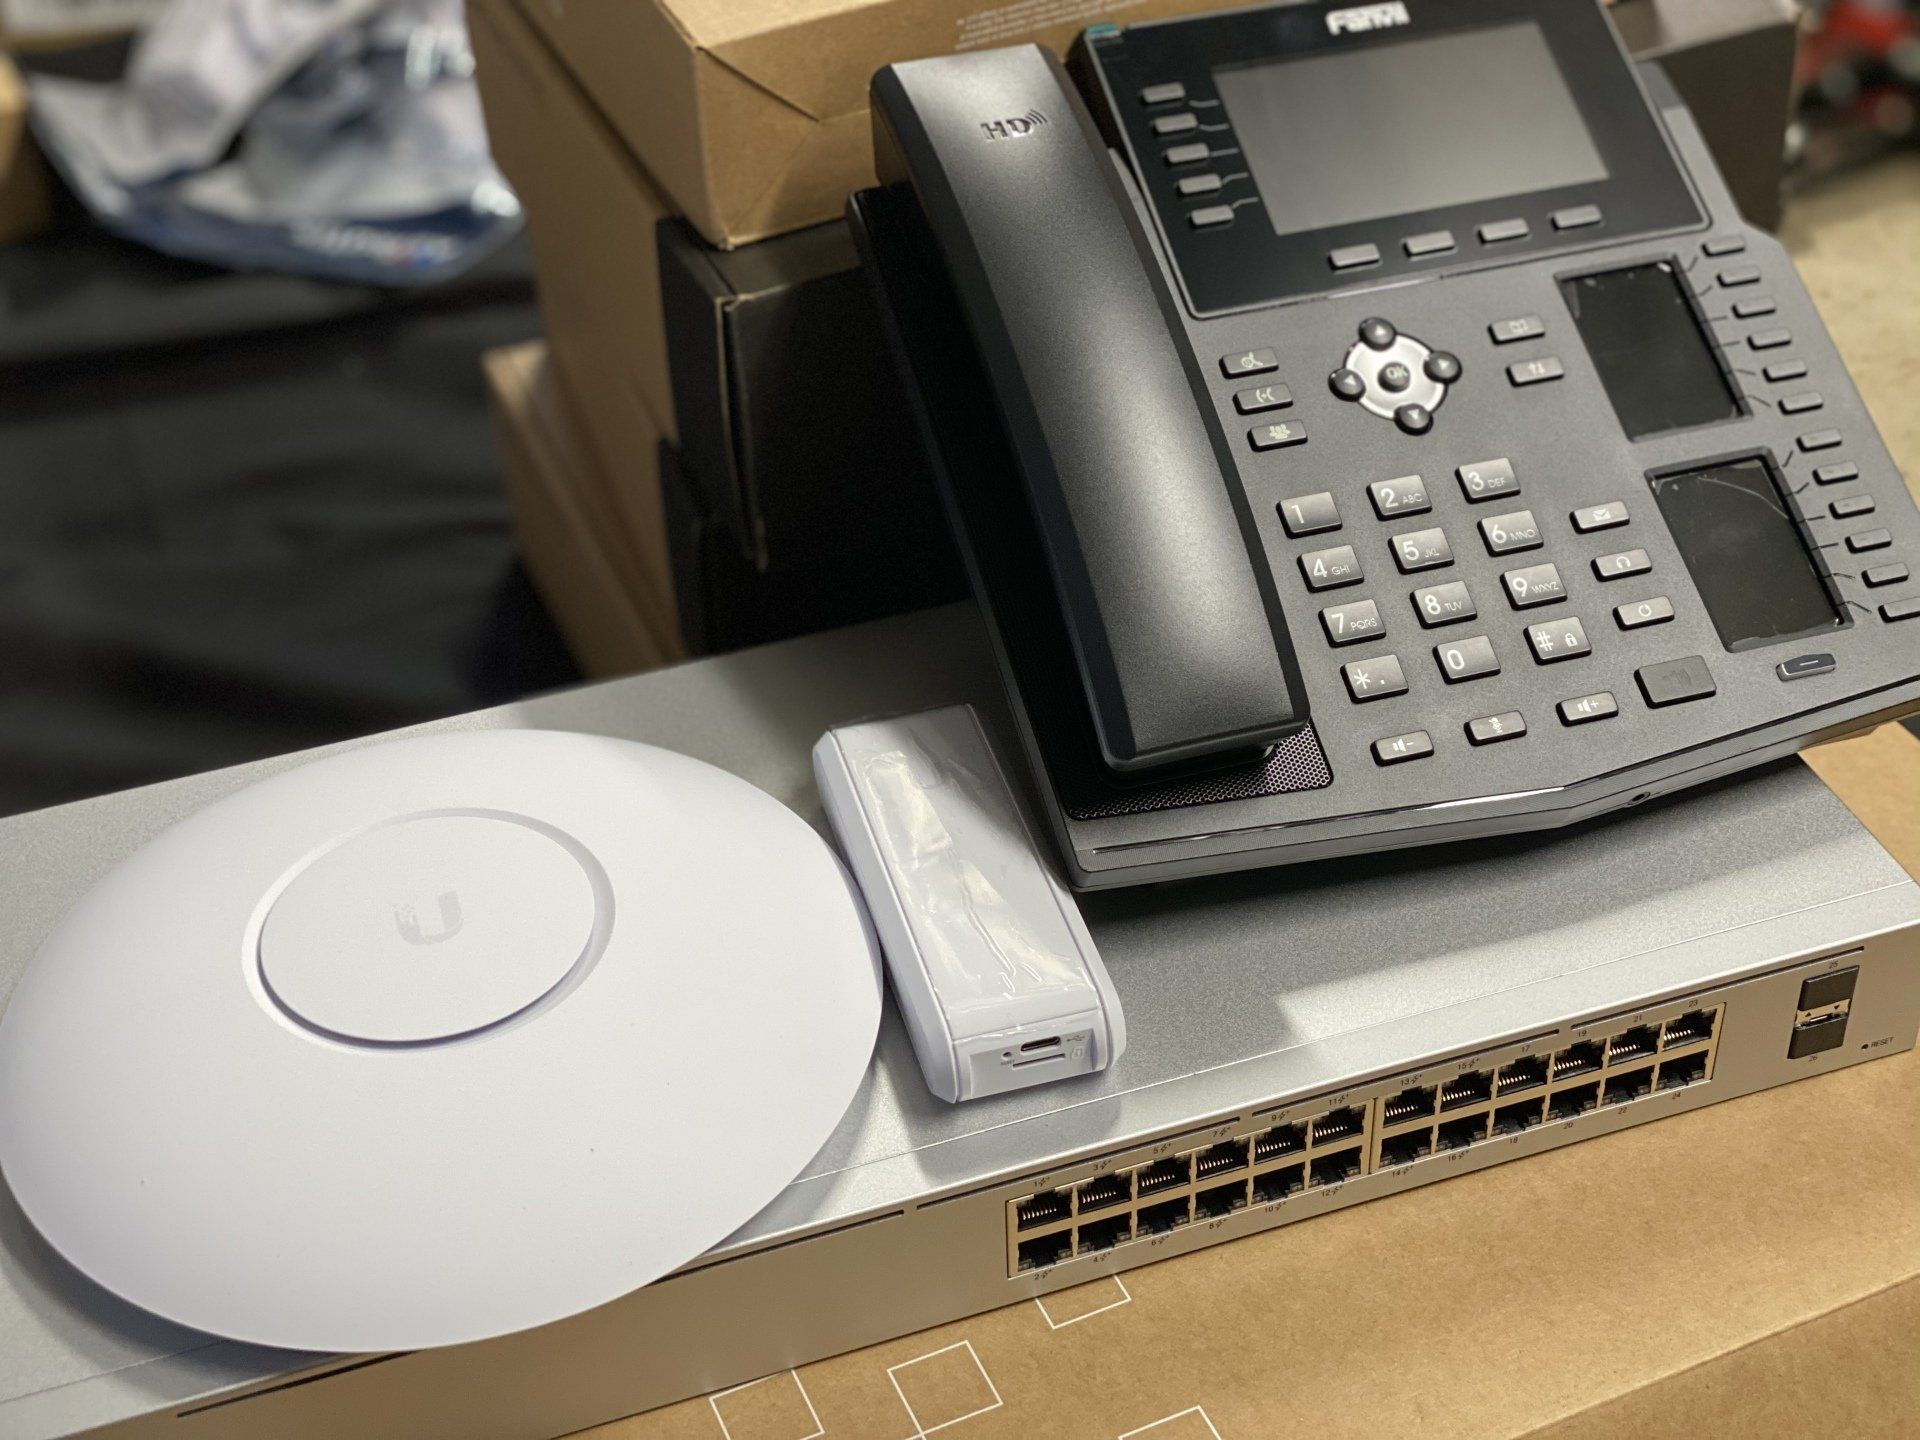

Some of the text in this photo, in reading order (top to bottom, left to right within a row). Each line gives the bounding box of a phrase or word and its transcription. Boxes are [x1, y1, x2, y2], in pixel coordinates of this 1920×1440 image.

[980, 118, 1033, 140] HD
[1389, 365, 1407, 379] OK
[1469, 471, 1506, 491] 3 DEF
[1380, 487, 1423, 508] 2 ABC
[1290, 505, 1305, 525] 1
[1491, 523, 1536, 544] 6 MNO
[1404, 541, 1439, 562] 5 JKL
[1312, 558, 1350, 579] 4 GHI
[1512, 577, 1559, 596] 9 WXYZ
[1423, 594, 1462, 615] 8 TUV
[1330, 612, 1378, 634] 7 PQRS
[1446, 650, 1465, 671] 0
[1870, 1036, 1894, 1049] RESET
